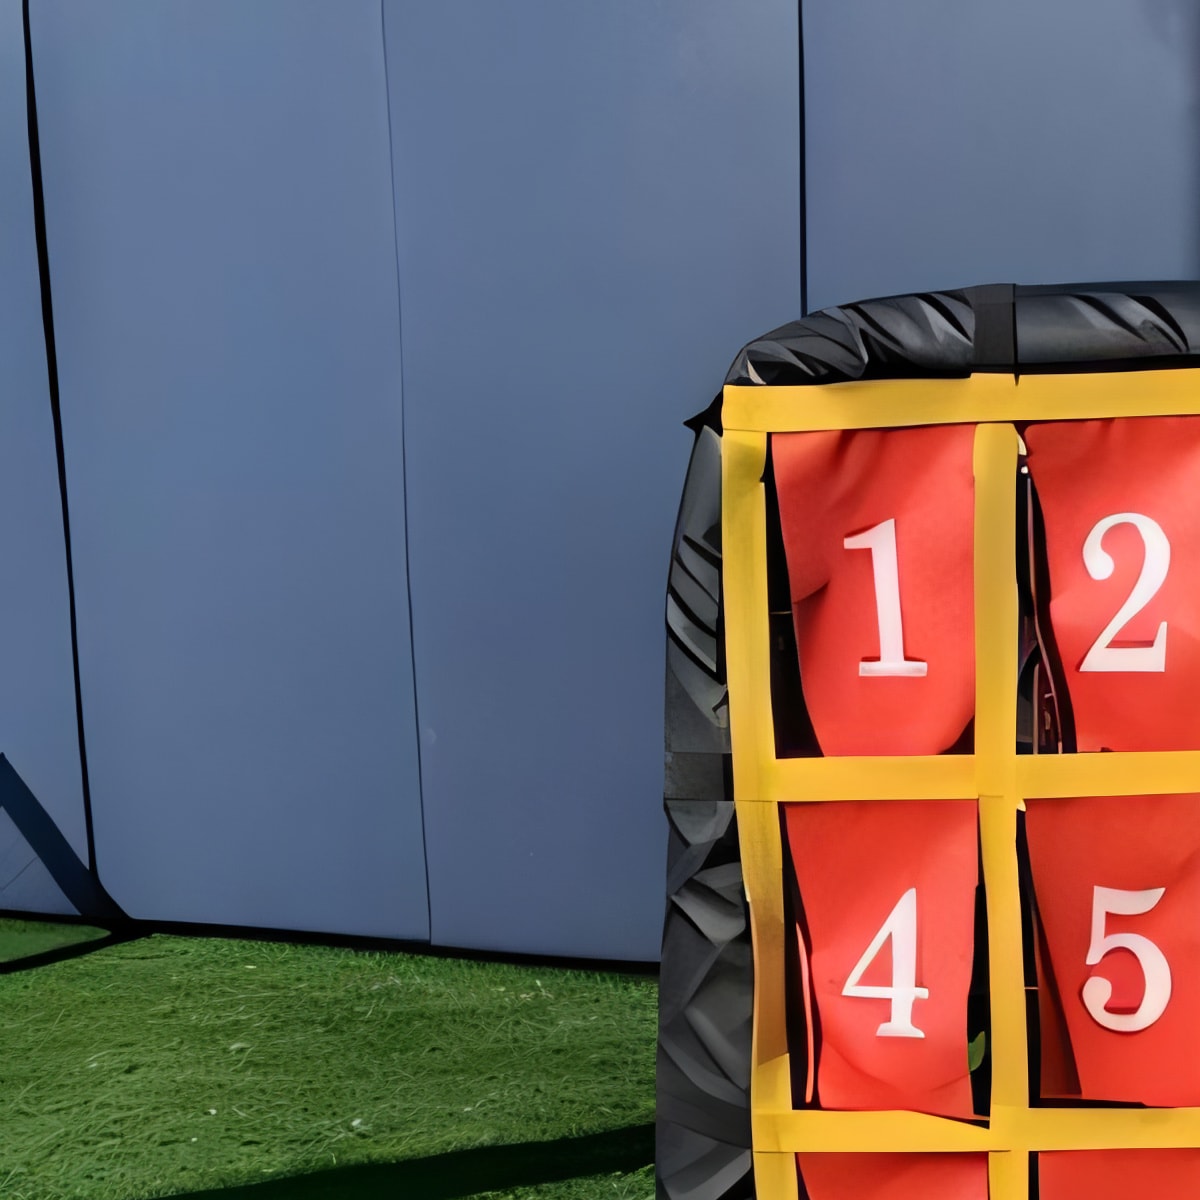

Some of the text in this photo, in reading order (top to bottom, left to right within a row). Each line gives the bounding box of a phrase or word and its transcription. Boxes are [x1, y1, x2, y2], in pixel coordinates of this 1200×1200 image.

[843, 518, 928, 677] 1
[1078, 512, 1172, 673] 2
[841, 887, 930, 1039] 4
[1082, 885, 1172, 1032] 5
